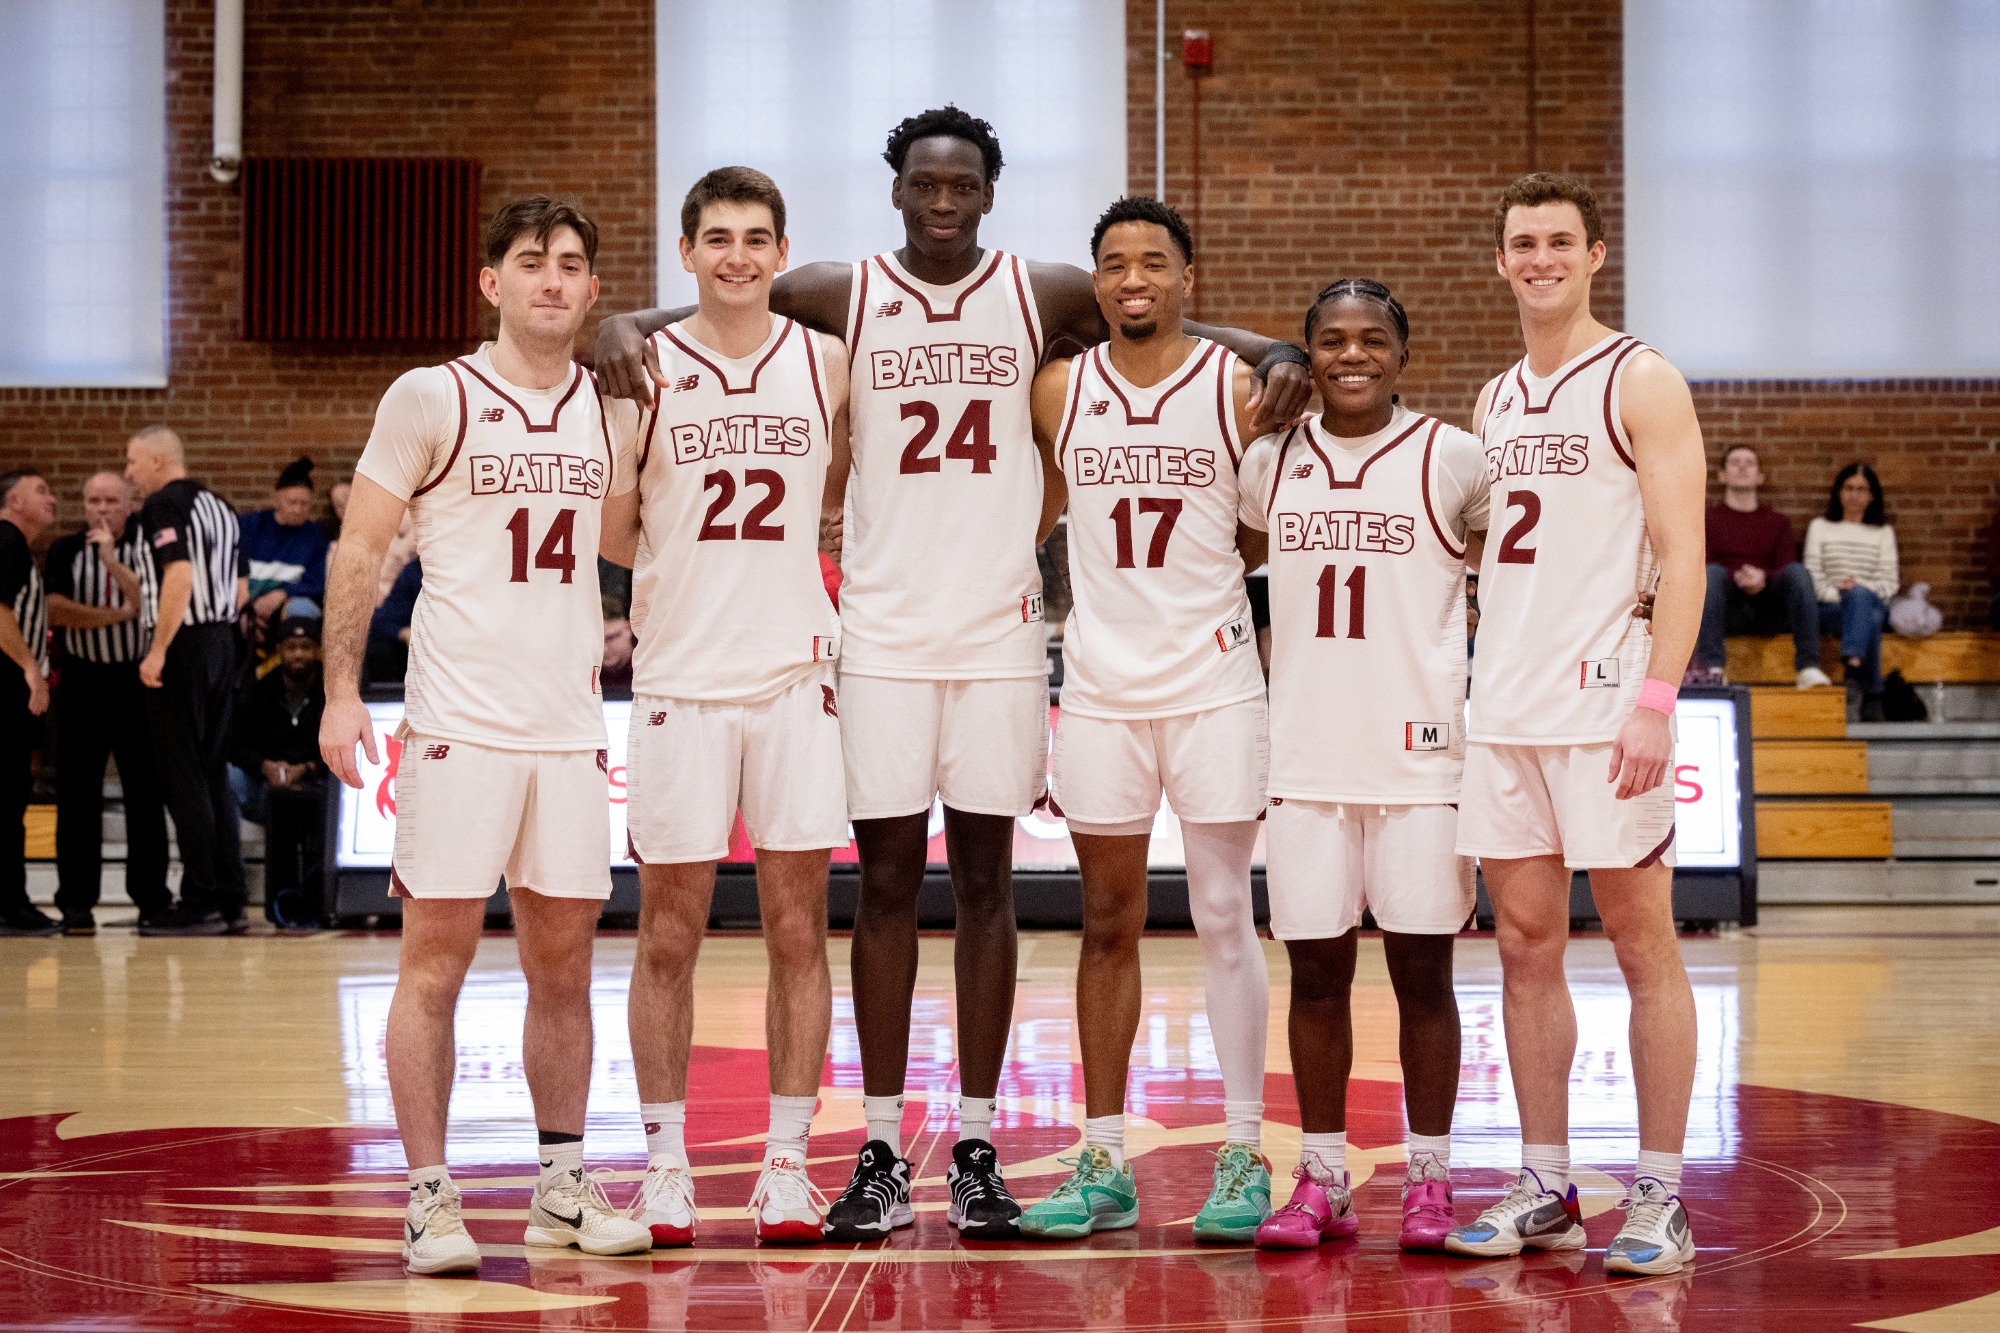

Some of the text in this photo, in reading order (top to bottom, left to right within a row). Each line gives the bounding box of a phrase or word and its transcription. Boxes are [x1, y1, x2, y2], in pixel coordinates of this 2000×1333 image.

[871, 343, 1019, 390] BATES
[671, 414, 811, 465] BATES
[900, 399, 997, 475] 24
[1485, 434, 1589, 485] BATES
[470, 453, 604, 500] BATES
[1074, 445, 1216, 487] BATES
[697, 468, 786, 542] 22
[1497, 489, 1541, 565] 2
[505, 507, 577, 584] 14
[1109, 497, 1183, 569] 17
[1278, 511, 1415, 555] BATES
[1315, 564, 1366, 640] 11
[827, 641, 833, 657] L
[1596, 663, 1607, 679] L
[1422, 727, 1438, 743] M
